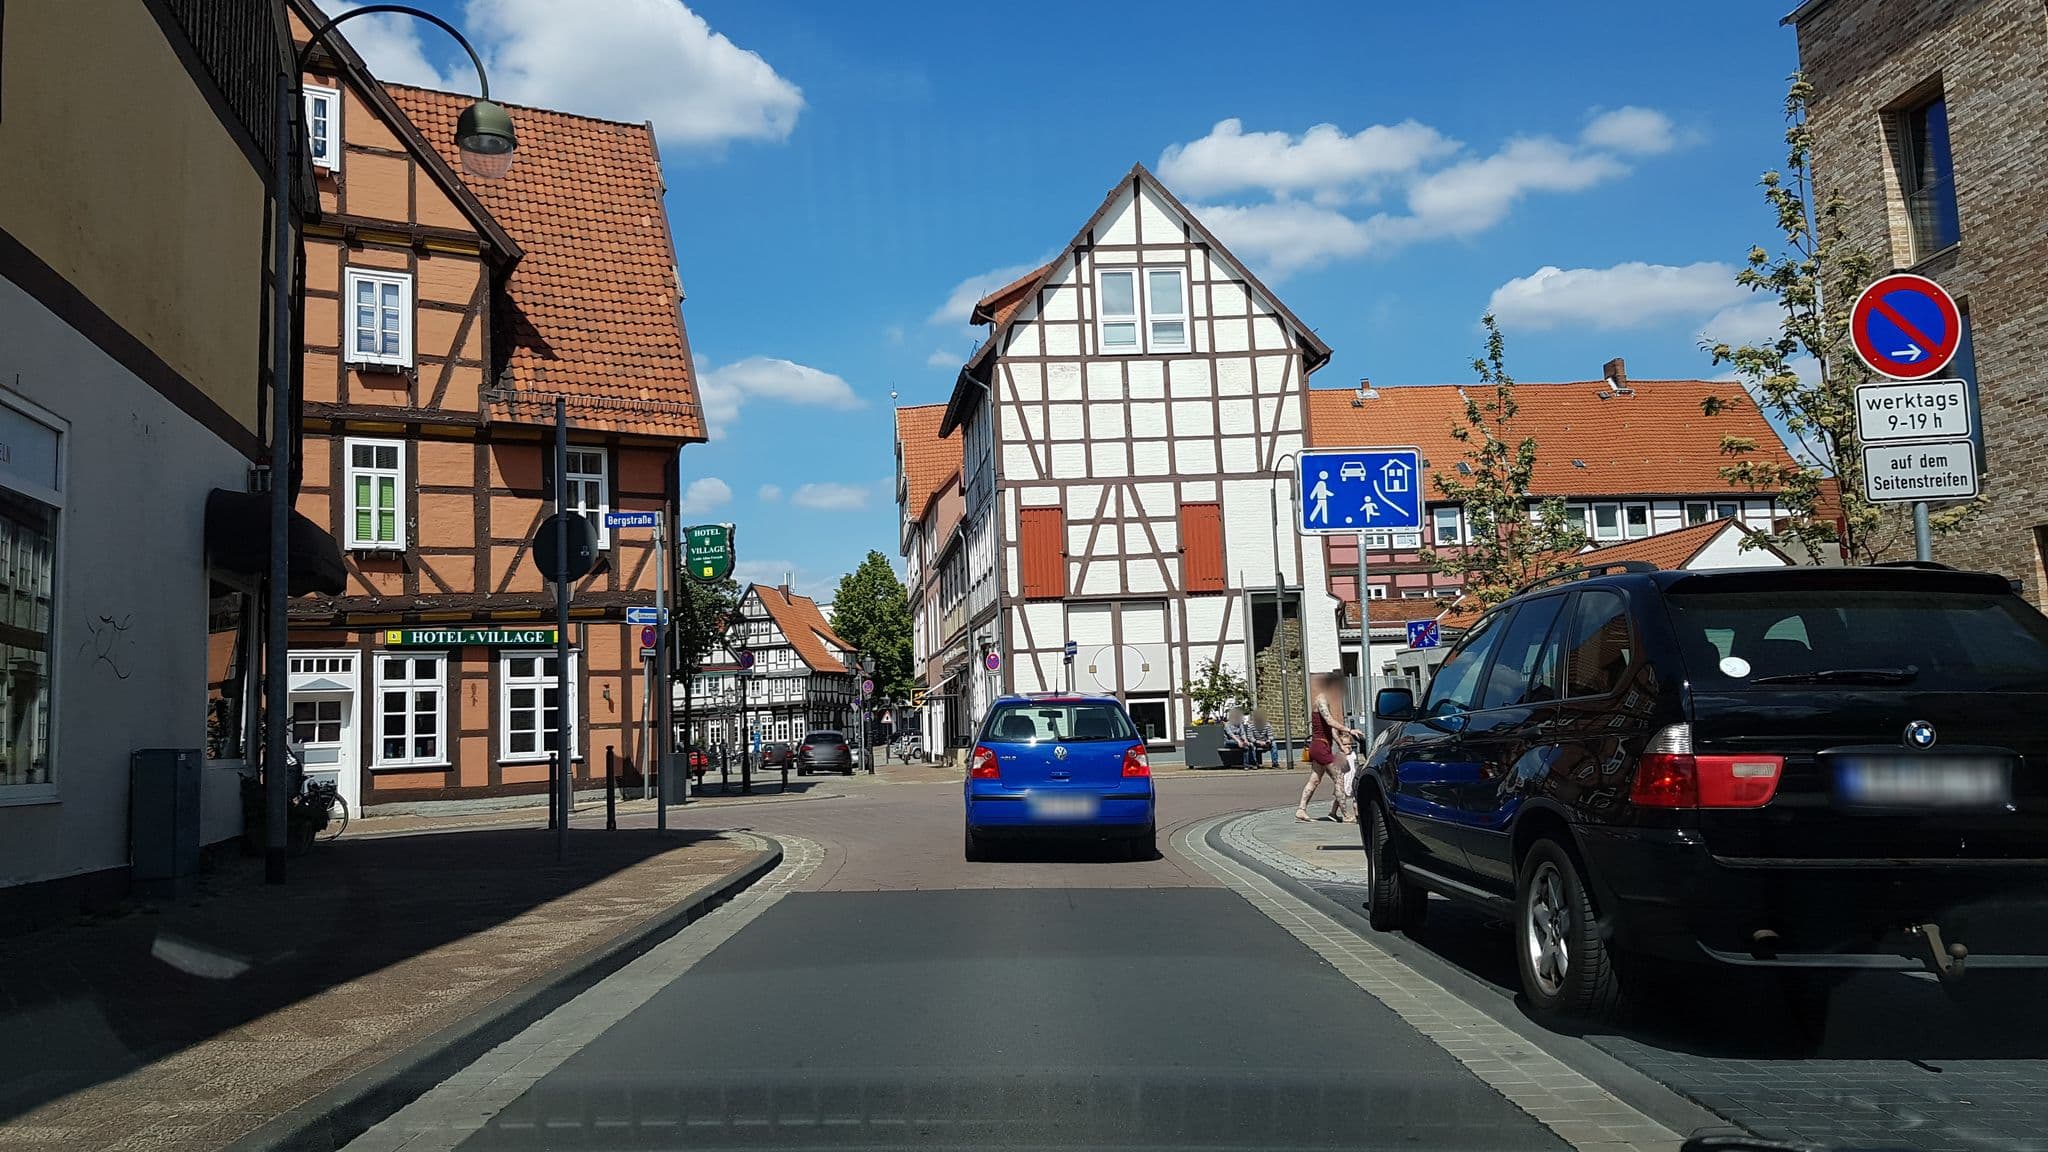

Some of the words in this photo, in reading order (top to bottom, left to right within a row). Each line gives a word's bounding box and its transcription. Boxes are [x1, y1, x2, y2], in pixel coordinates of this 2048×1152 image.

[1866, 392, 1958, 411] werktags
[1933, 412, 1942, 428] h
[1890, 454, 1913, 470] auf
[1919, 454, 1948, 468] dem
[1873, 473, 1969, 491] Seitenstreifen
[608, 515, 652, 527] Bergstraße
[694, 528, 721, 537] HOTEL
[691, 545, 726, 555] VILLAGE
[412, 631, 467, 643] HOTEL
[477, 631, 545, 643] VILLAGE
